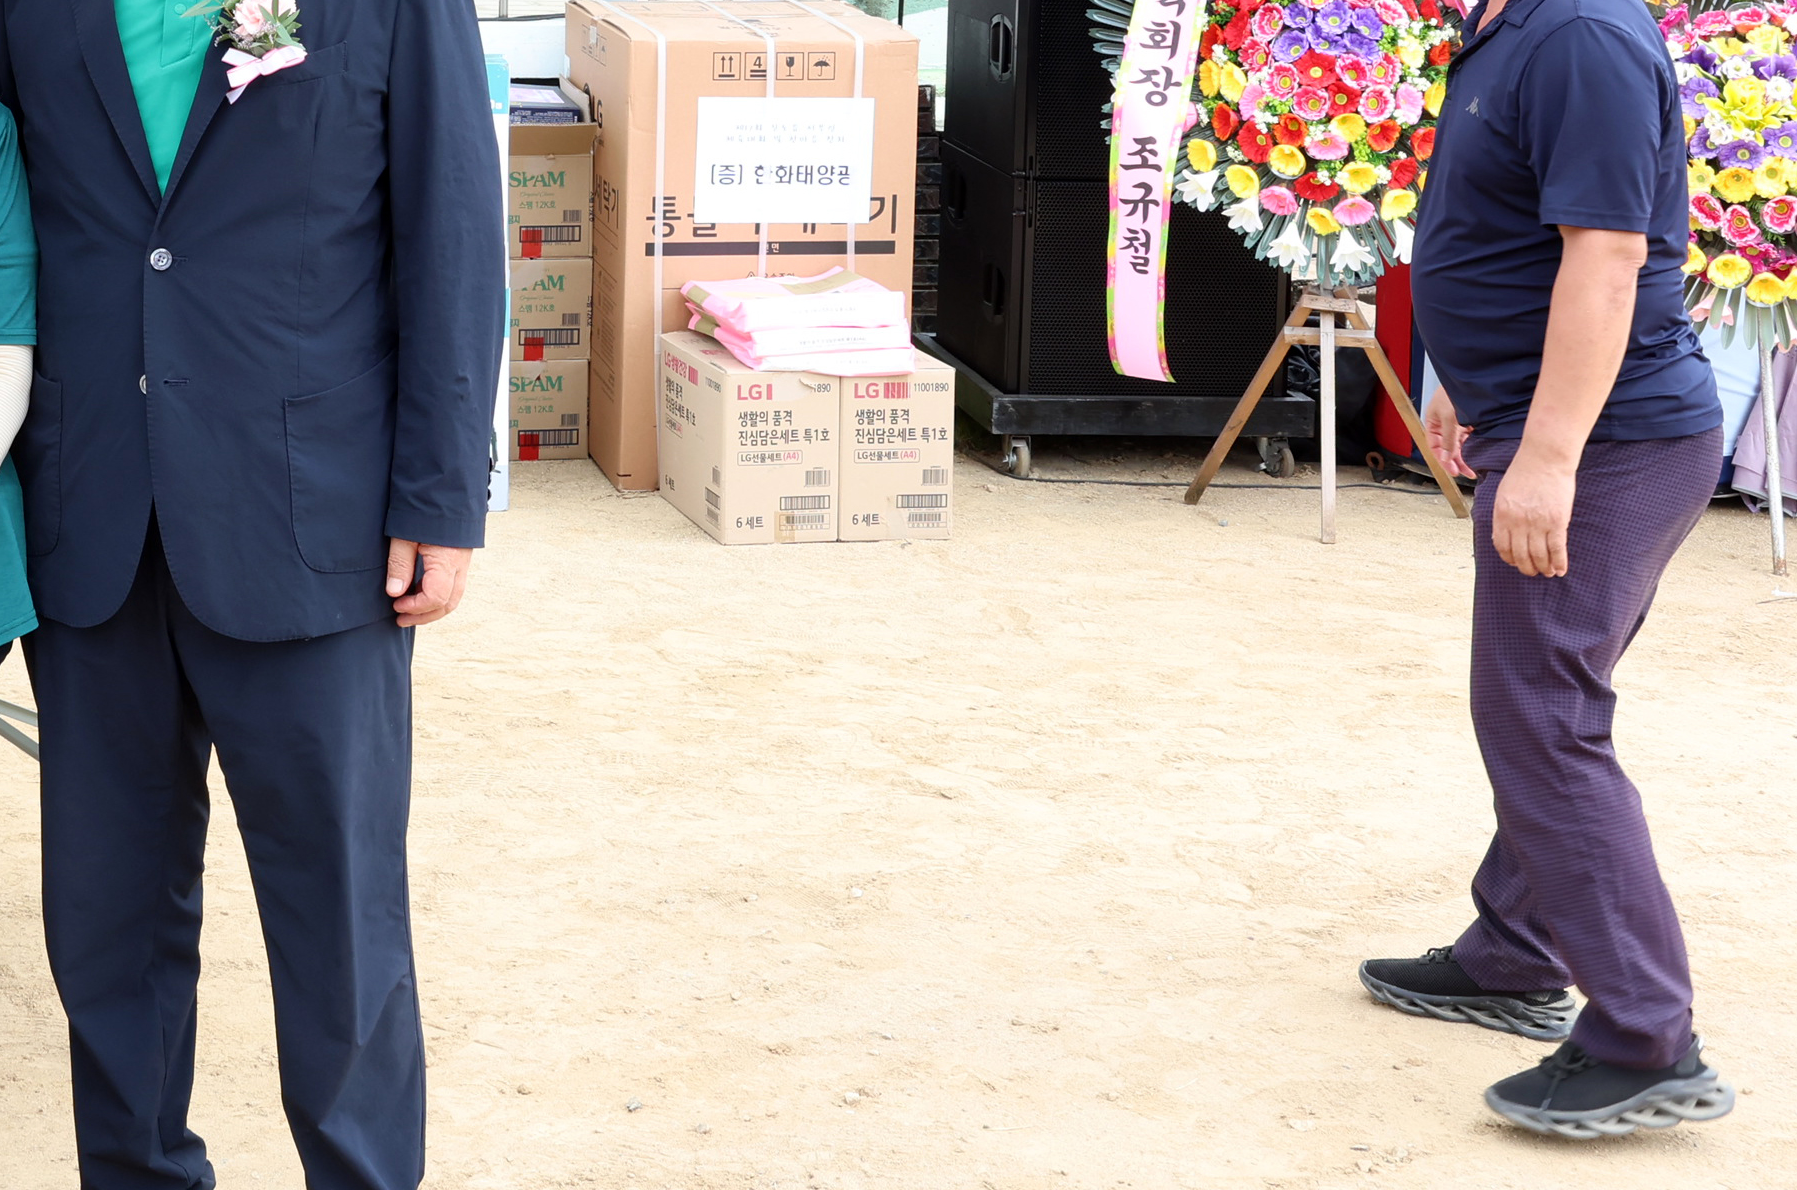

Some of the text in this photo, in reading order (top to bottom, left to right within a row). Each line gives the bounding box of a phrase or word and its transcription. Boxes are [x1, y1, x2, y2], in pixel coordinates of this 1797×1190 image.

[509, 171, 566, 188] SPAM
[1119, 135, 1164, 277] 조규철
[509, 375, 564, 392] SPAM
[854, 383, 880, 399] LG
[914, 382, 949, 393] 11001890
[737, 384, 762, 401] LG
[738, 410, 793, 428] 생활의 품격
[855, 408, 910, 426] 생활의 품격
[738, 428, 830, 447] 진심담은세트 특1호
[855, 426, 948, 445] 진심담은세트 특1호
[736, 516, 764, 530] 6 세트
[852, 513, 880, 527] 6 세트
